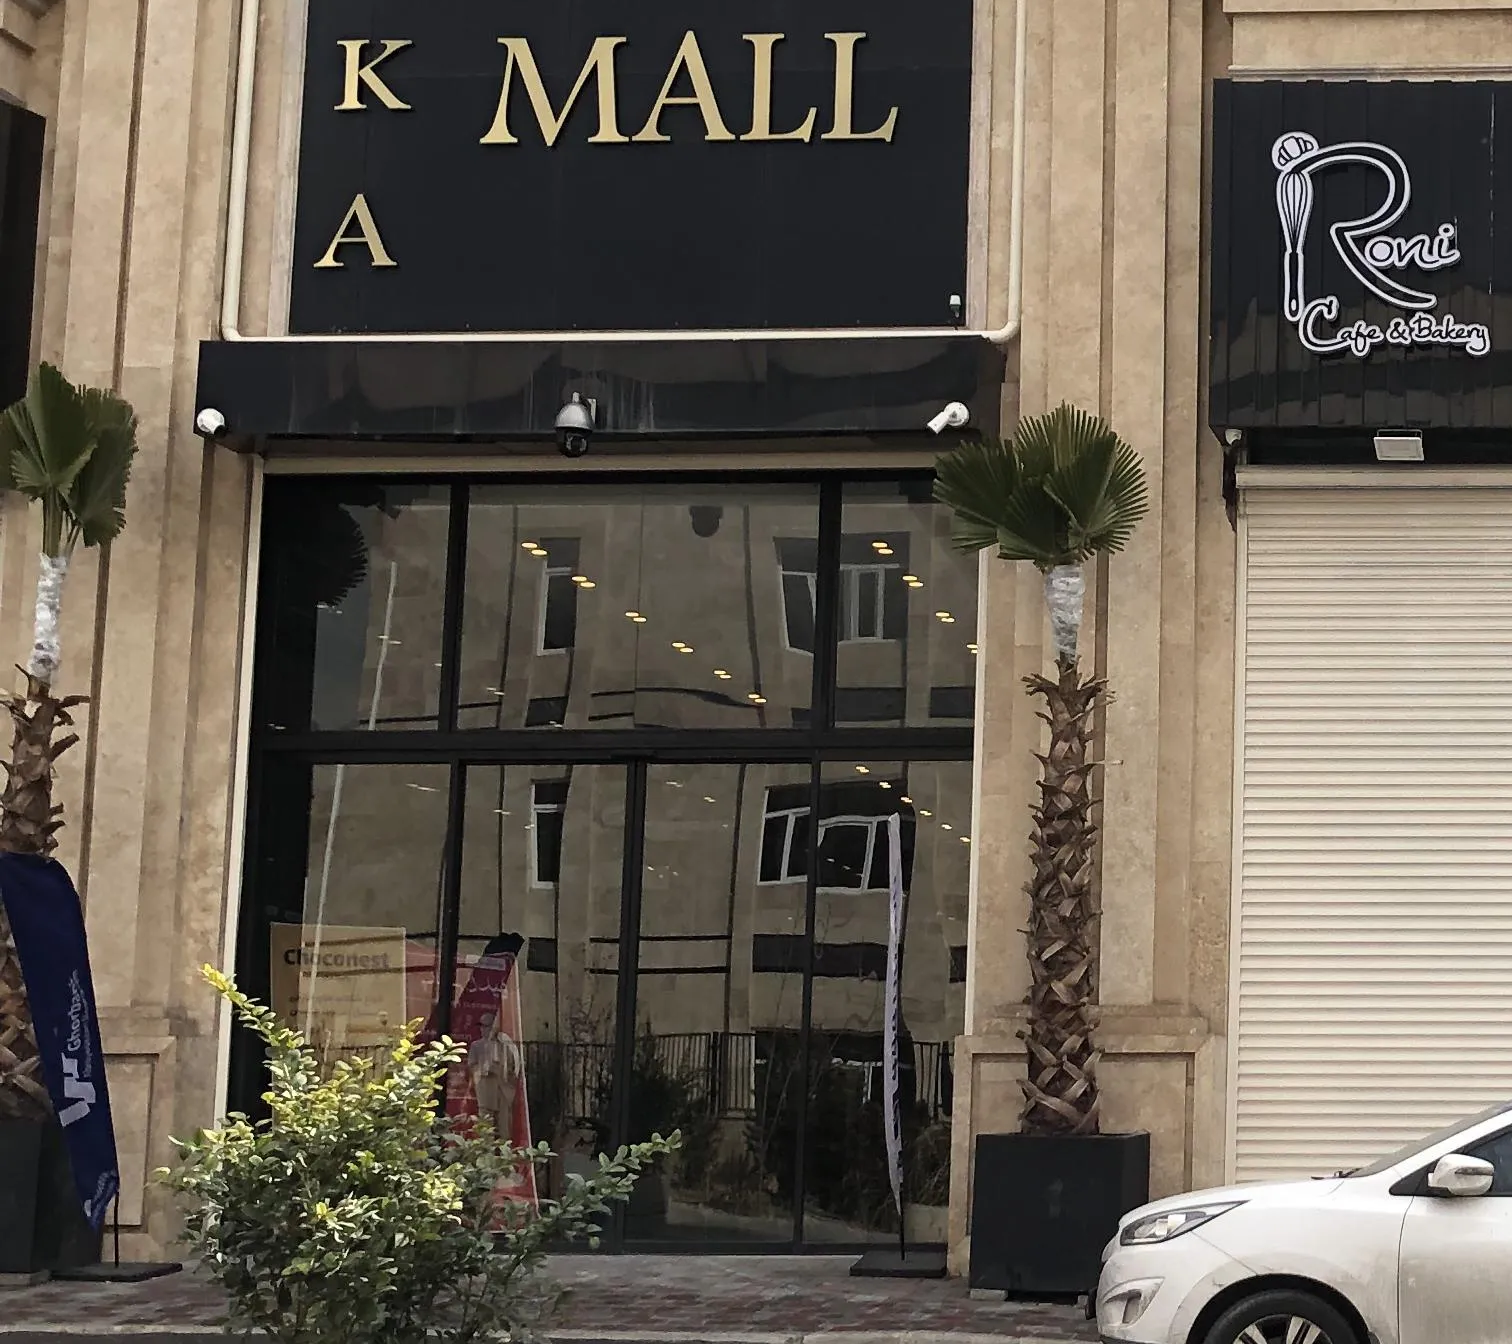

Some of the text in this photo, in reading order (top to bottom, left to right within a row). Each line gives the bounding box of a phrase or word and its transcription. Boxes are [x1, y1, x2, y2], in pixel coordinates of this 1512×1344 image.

[478, 29, 900, 147] MALL
[1274, 136, 1461, 324] Roni
[1300, 295, 1491, 357] Cafe & Bakery
